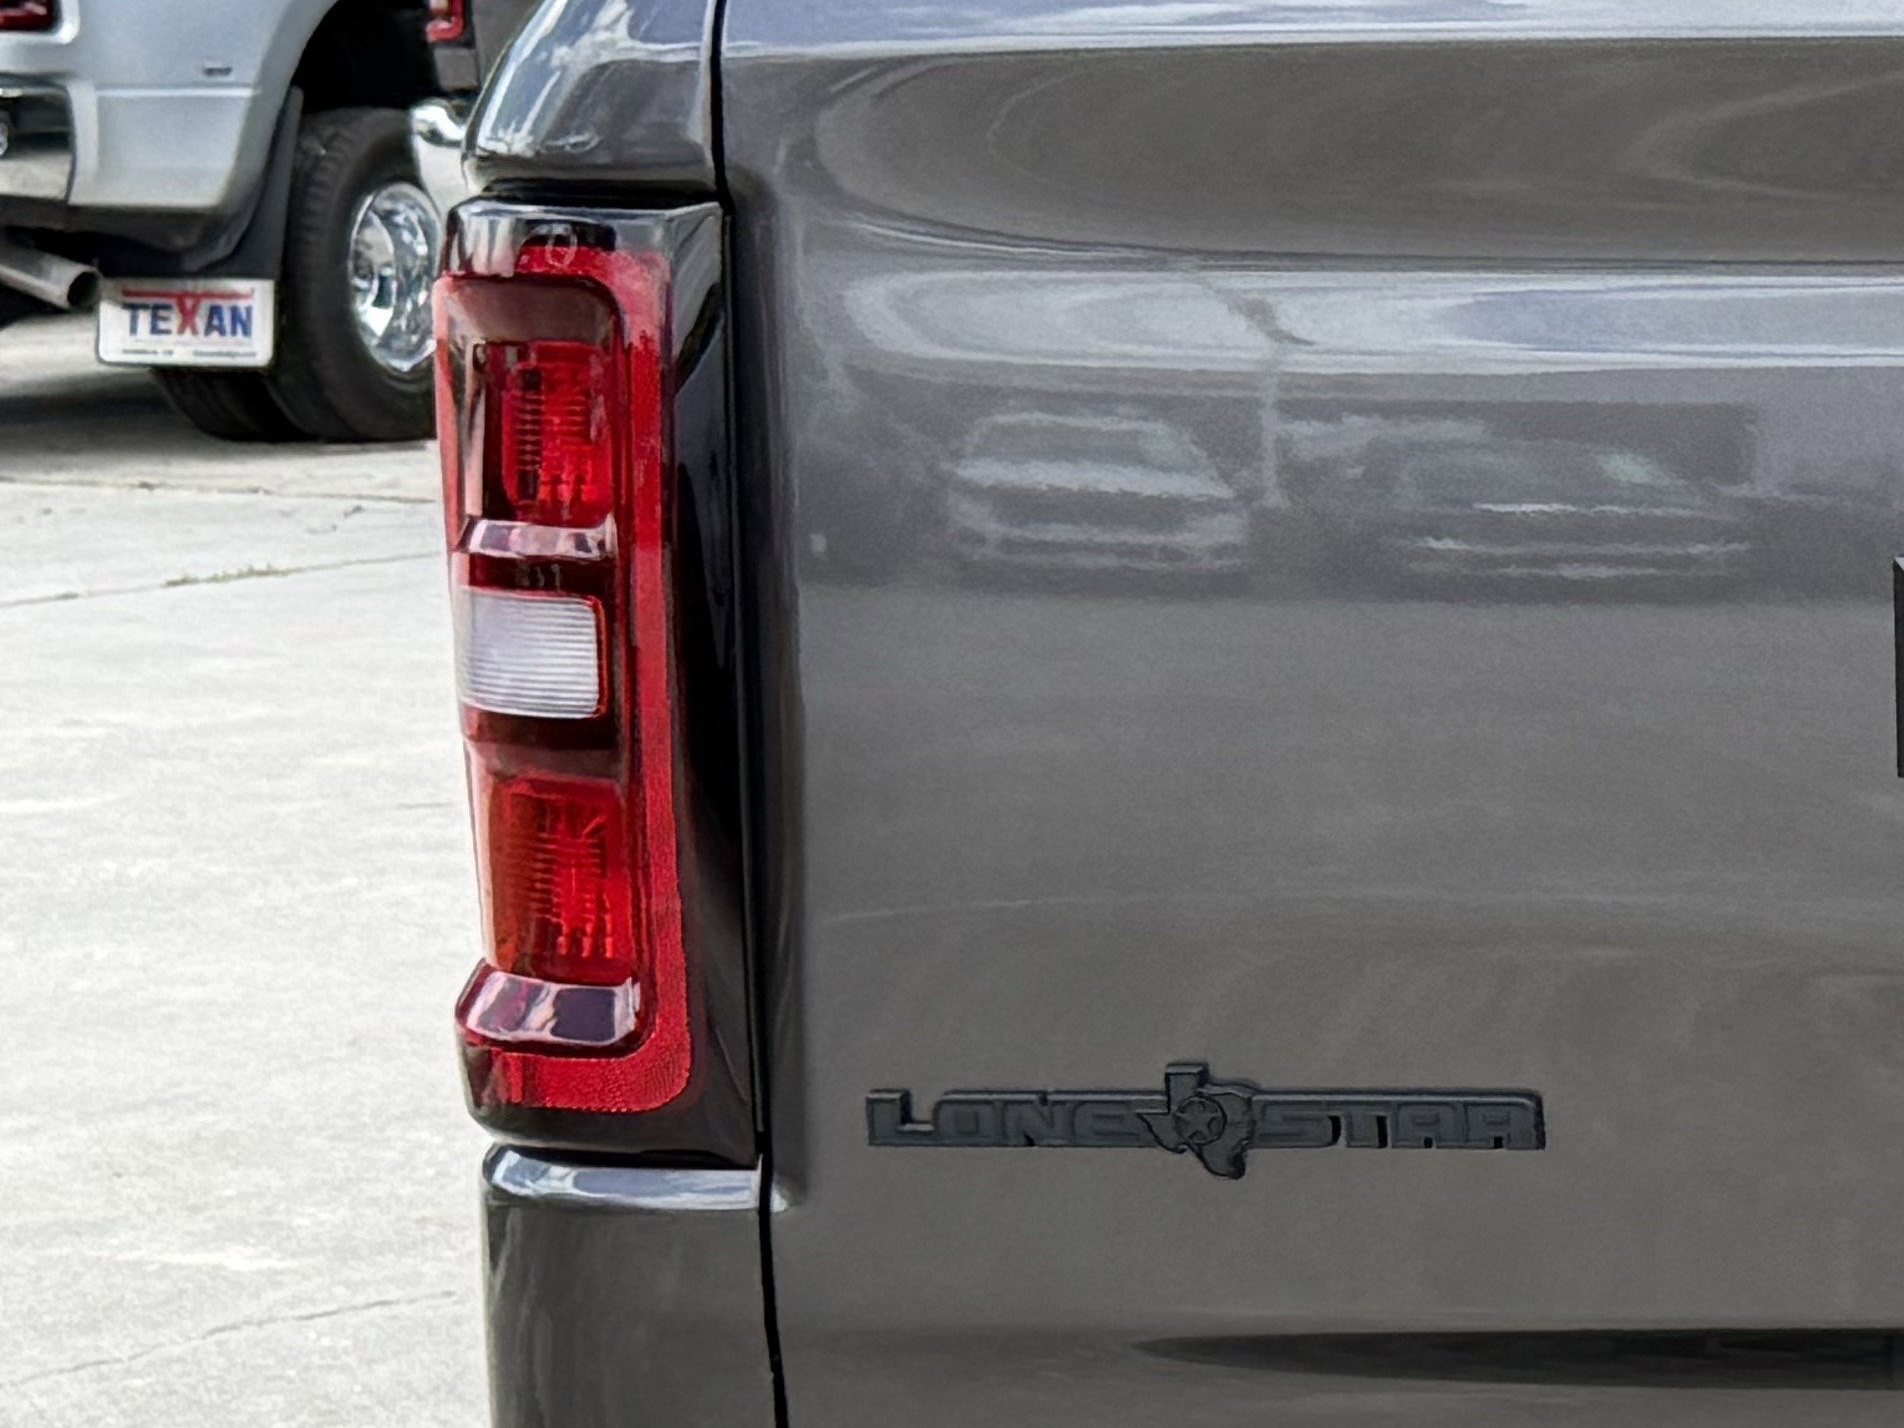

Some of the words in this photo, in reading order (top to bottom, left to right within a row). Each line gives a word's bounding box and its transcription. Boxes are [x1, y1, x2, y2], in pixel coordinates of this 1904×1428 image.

[122, 293, 252, 336] TEXAN
[866, 1088, 1150, 1148] LONE
[1251, 1089, 1546, 1151] STAR
